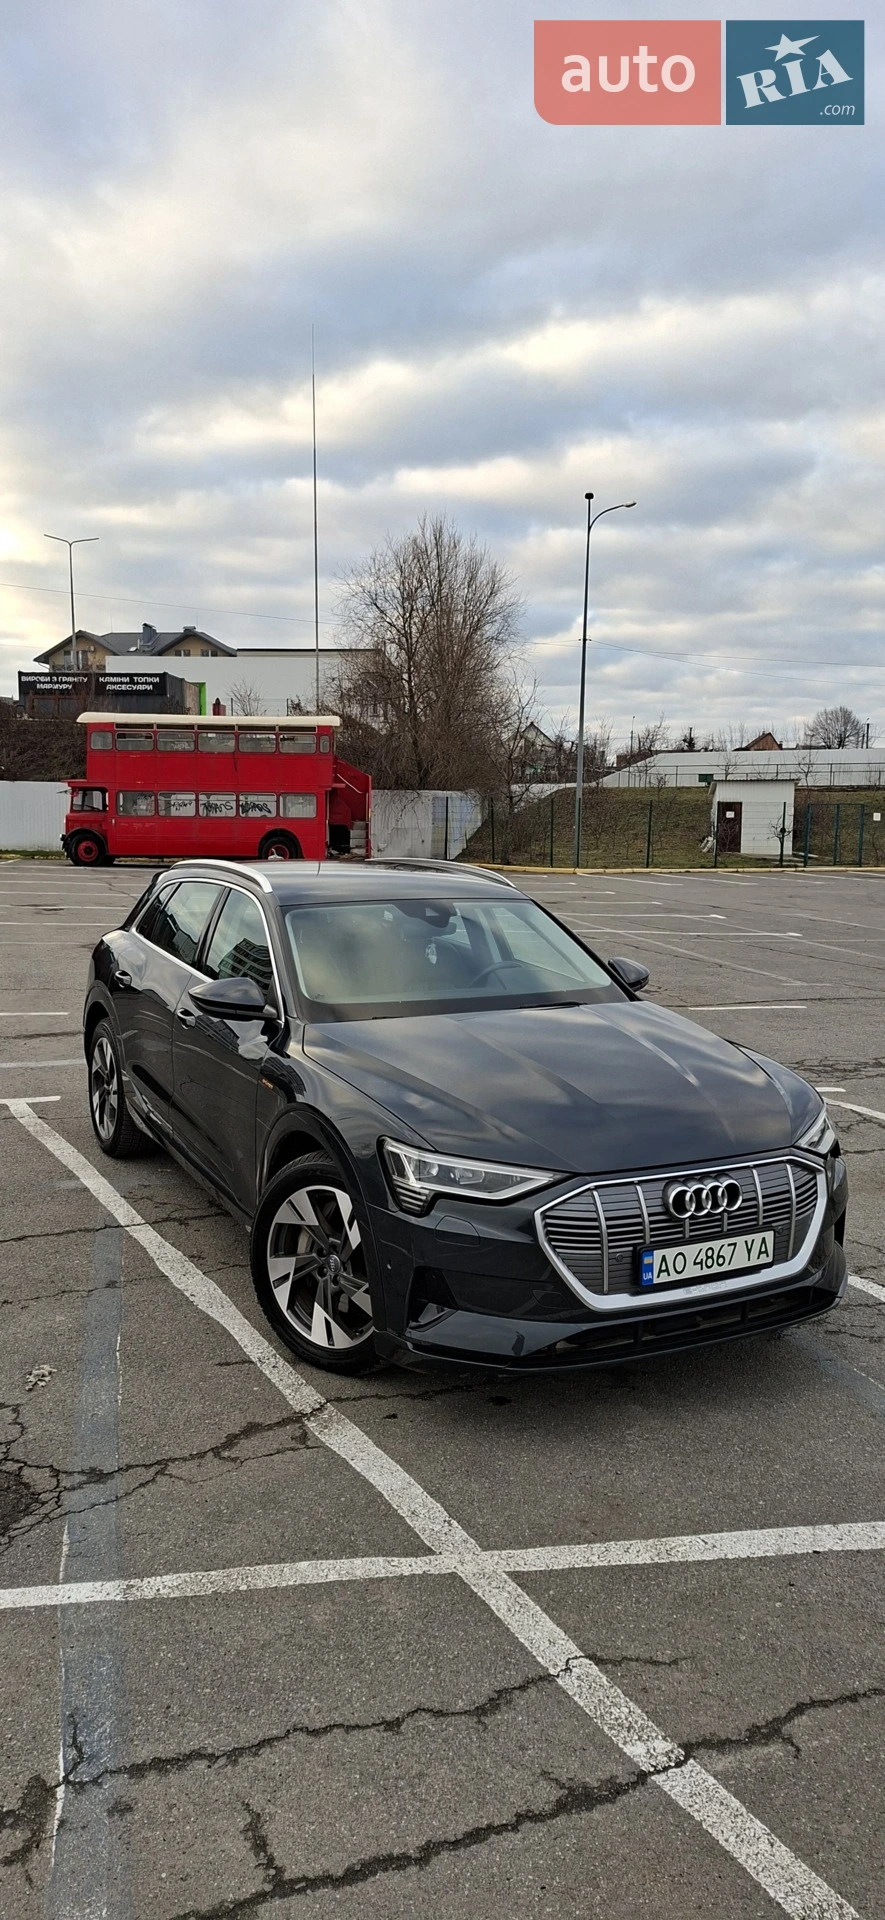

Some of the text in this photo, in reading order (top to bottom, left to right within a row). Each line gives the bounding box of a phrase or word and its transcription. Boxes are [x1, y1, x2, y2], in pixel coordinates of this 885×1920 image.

[656, 1236, 770, 1279] AO 4867 YA
[643, 1272, 653, 1281] UA
